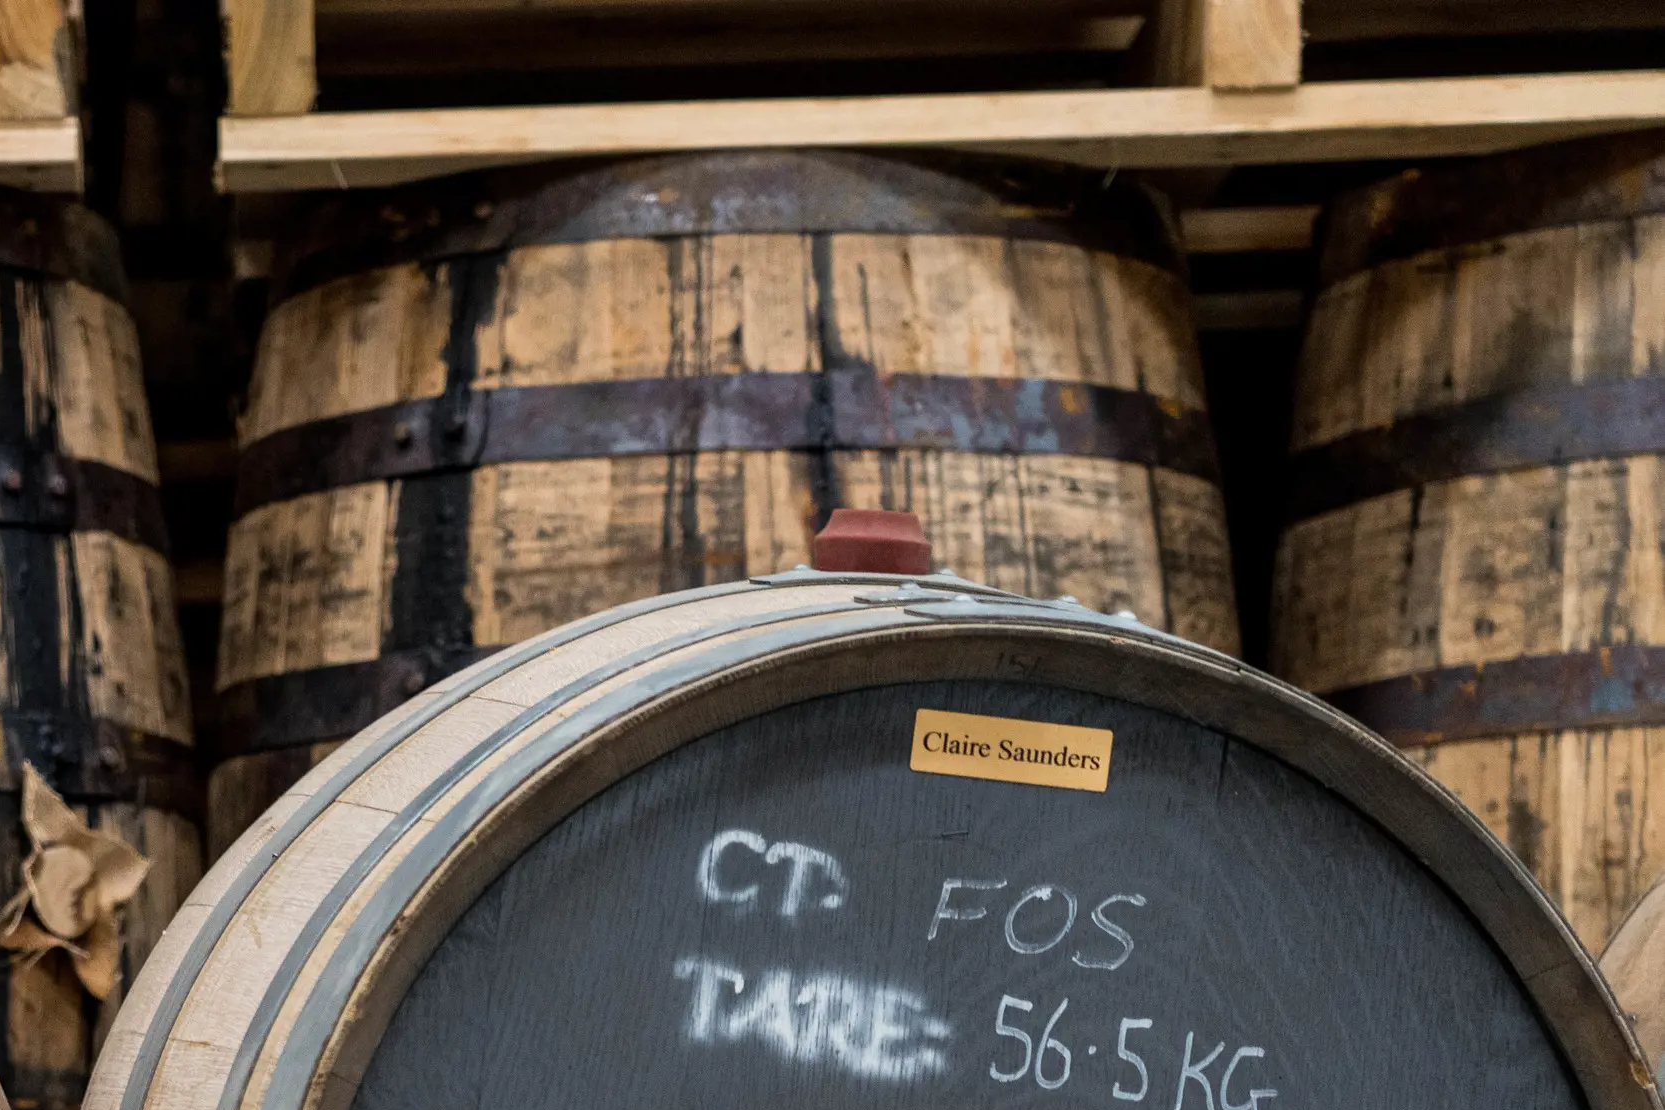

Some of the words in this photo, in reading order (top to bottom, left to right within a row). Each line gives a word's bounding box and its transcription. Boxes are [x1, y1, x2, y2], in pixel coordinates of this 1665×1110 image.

[922, 730, 991, 758] Claire
[998, 739, 1101, 771] Saunders
[927, 876, 1148, 971] FOS
